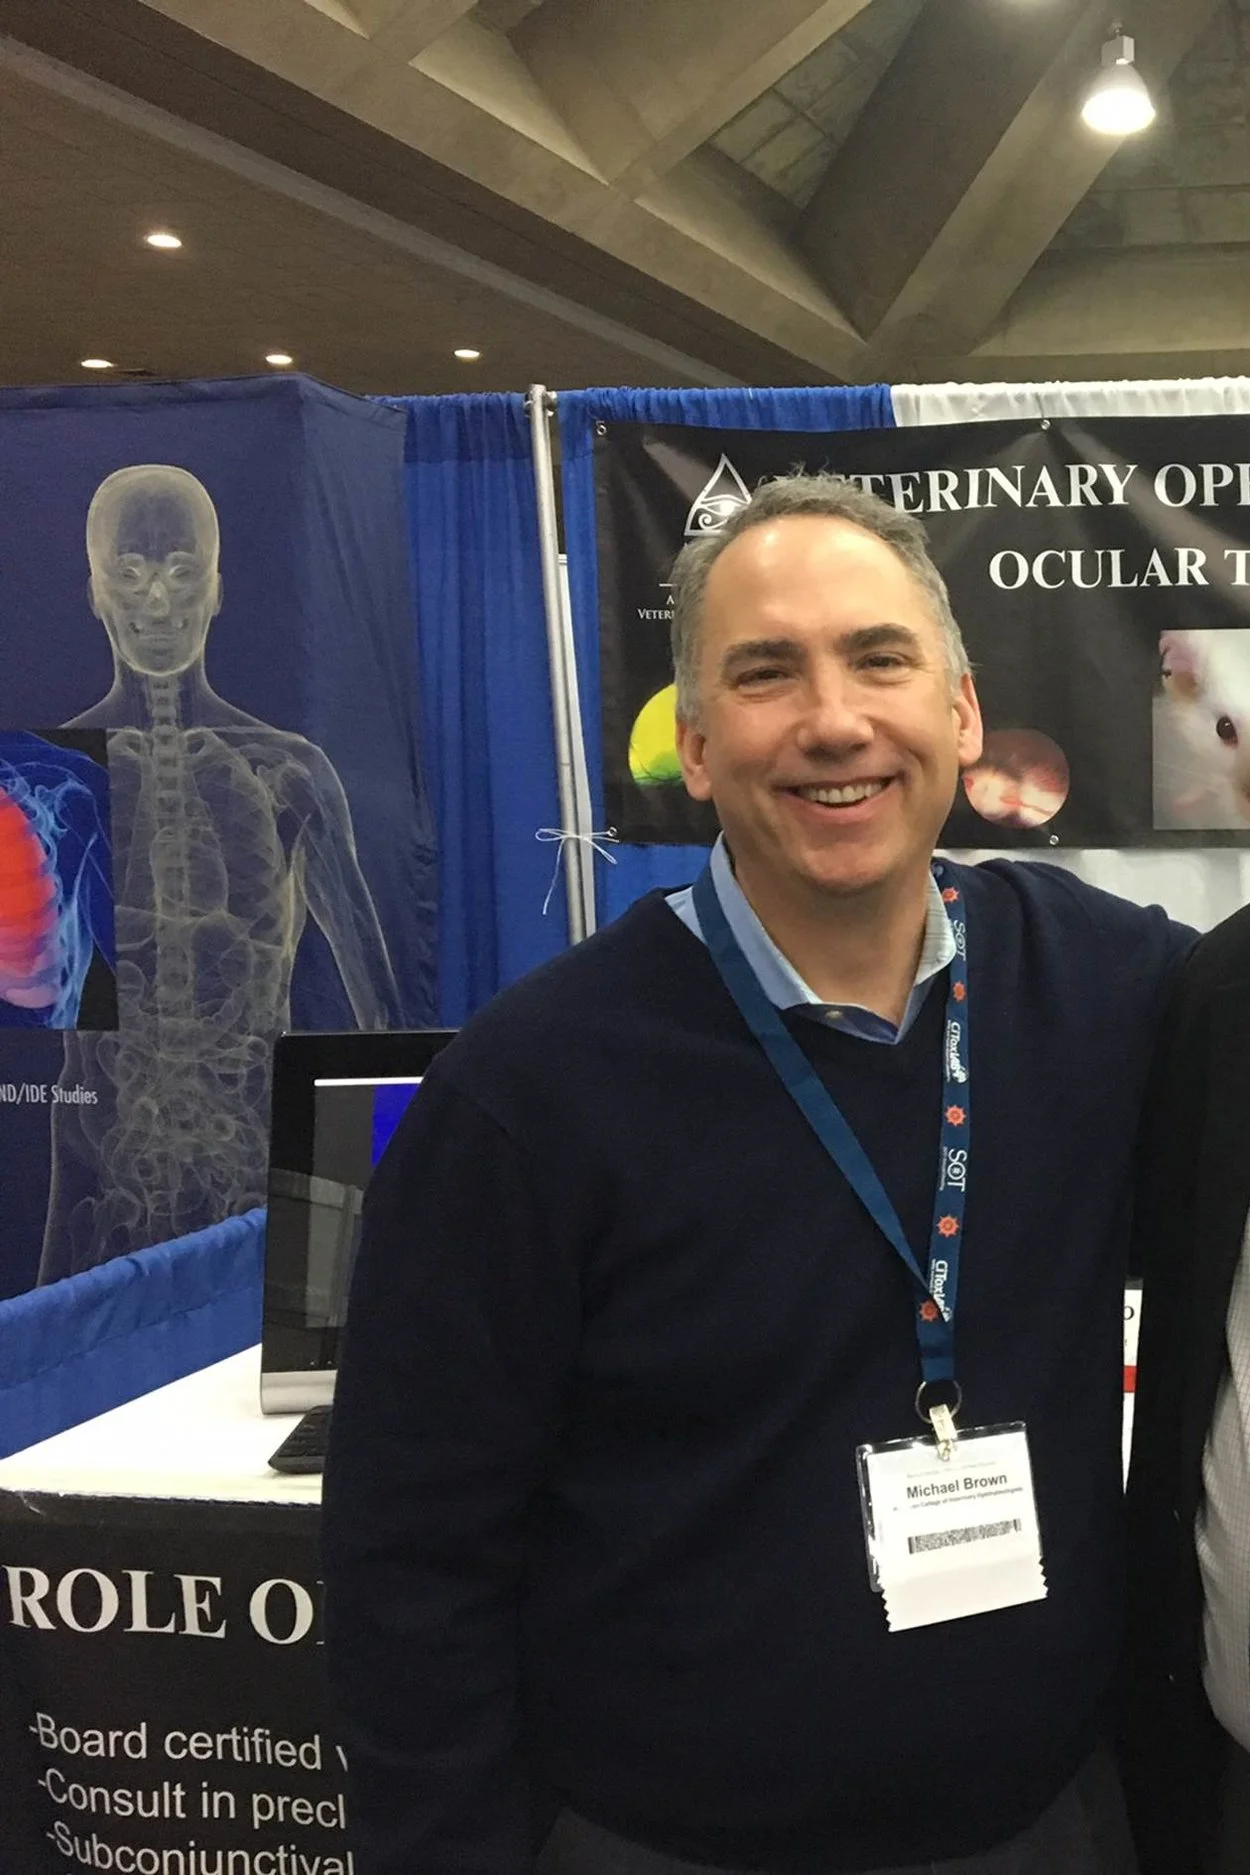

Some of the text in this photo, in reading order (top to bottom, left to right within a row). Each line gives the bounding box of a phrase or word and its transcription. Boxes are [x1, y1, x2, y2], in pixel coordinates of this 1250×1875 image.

[770, 464, 1138, 513] TERINARY
[989, 547, 1210, 589] OCULAR
[0, 1083, 98, 1105] ND/IDE Studies
[947, 1148, 968, 1192] SOT
[906, 1474, 1008, 1499] Michael Brown
[2, 1564, 325, 1645] ROLE O
[164, 1727, 322, 1770] certified
[201, 1781, 236, 1819] in
[252, 1793, 346, 1829] precl
